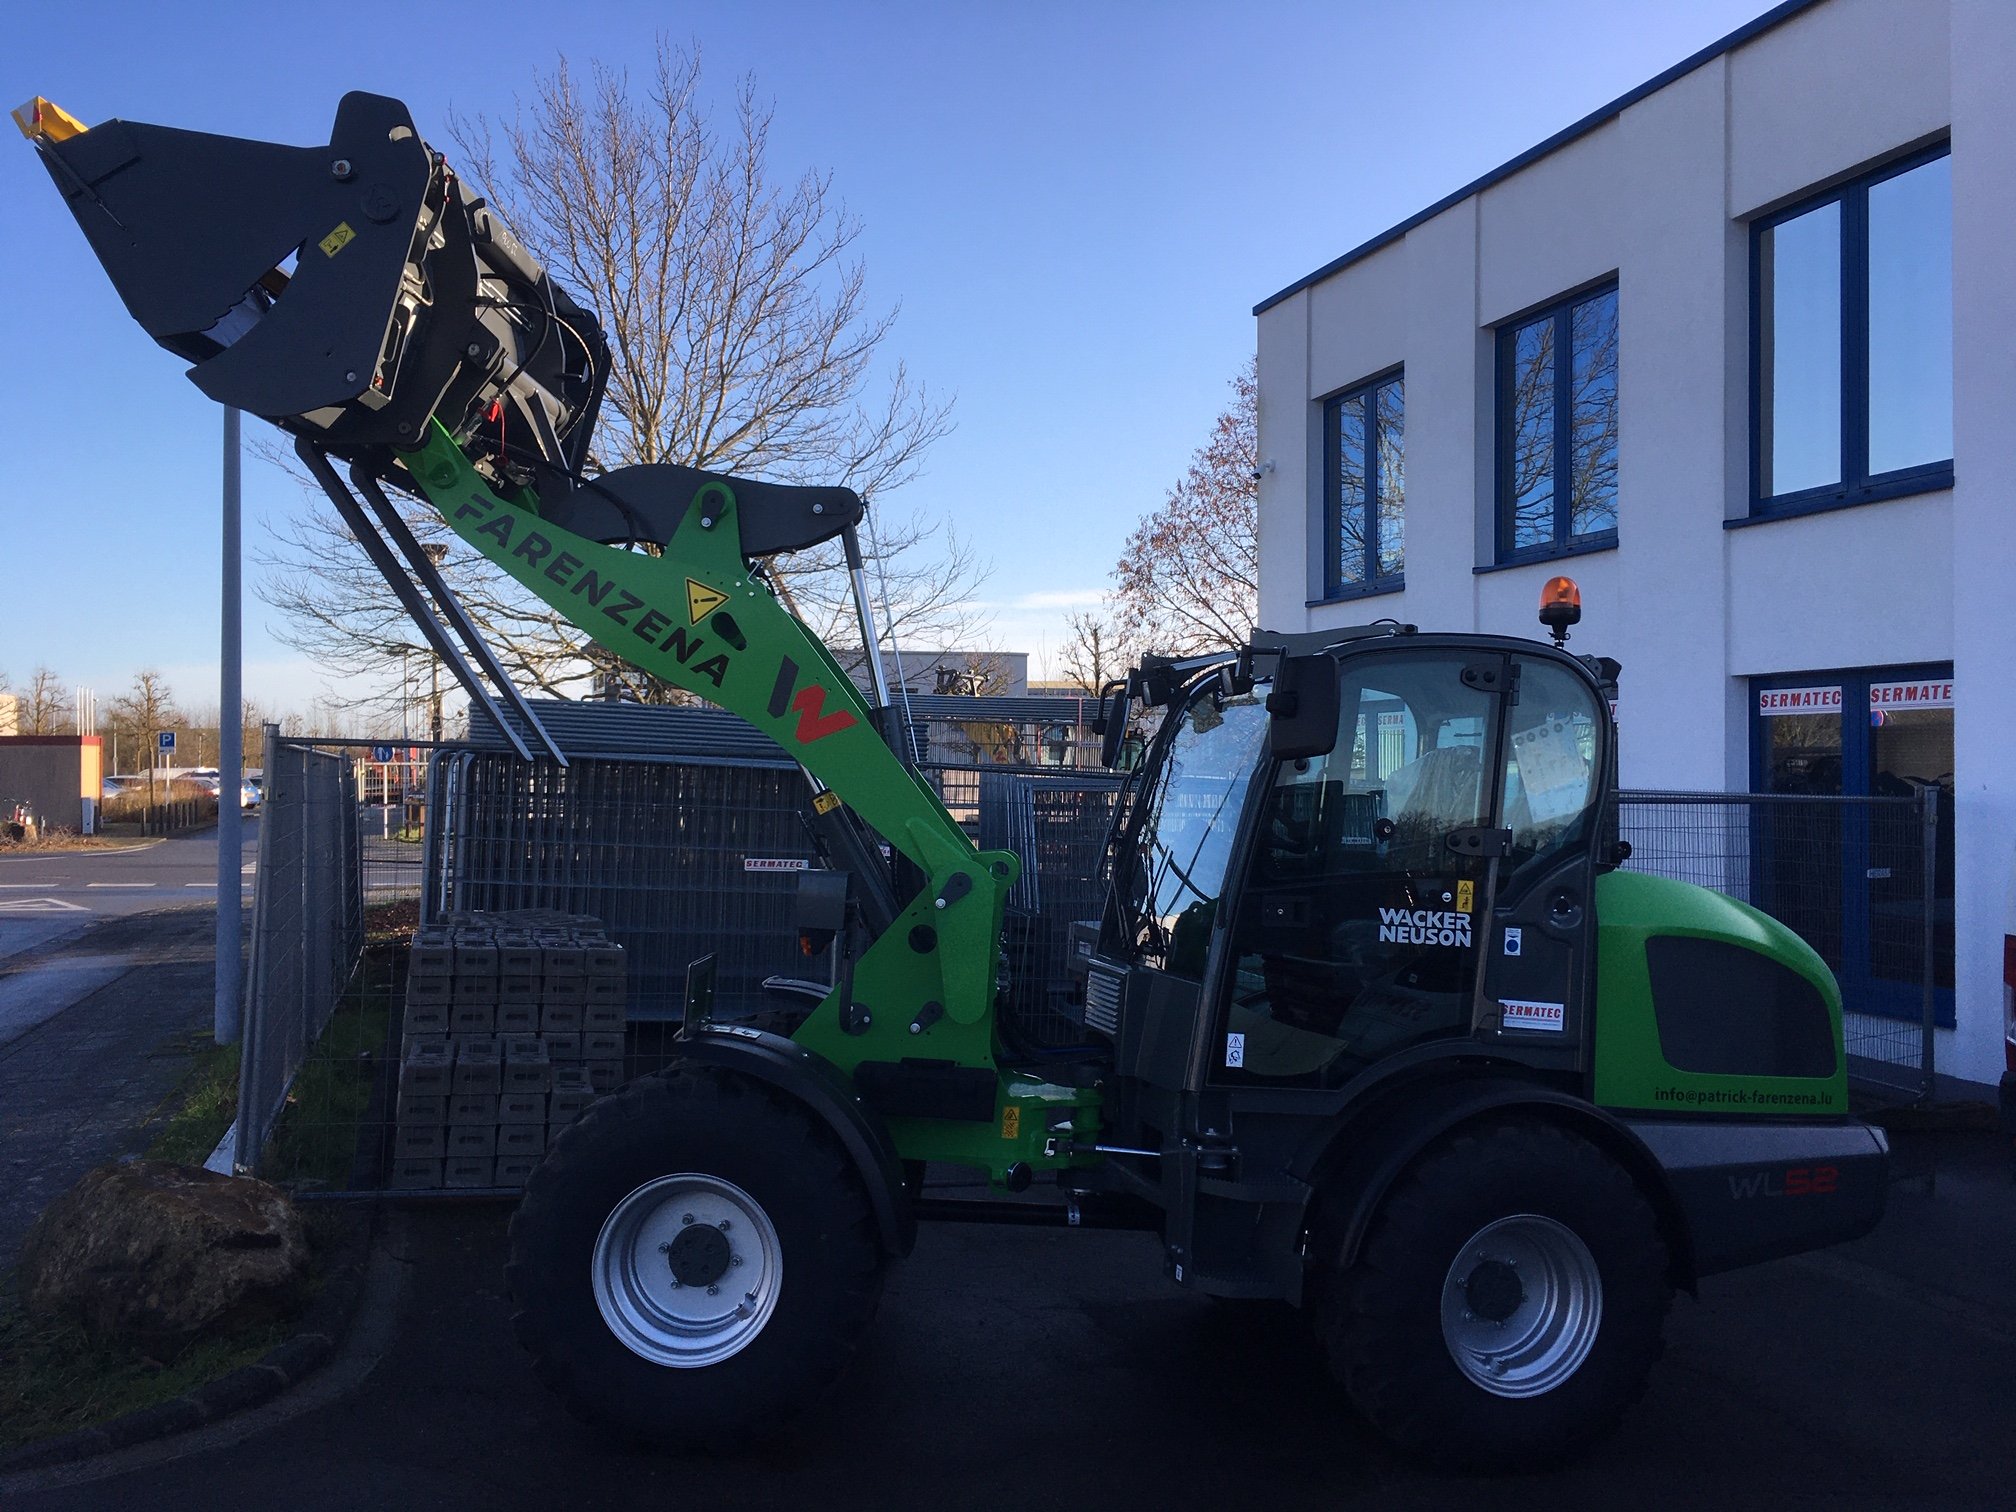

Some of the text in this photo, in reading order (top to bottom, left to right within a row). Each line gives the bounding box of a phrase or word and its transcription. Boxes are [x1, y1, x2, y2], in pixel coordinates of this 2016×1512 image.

[454, 493, 730, 688] FARENZENA
[1760, 690, 1842, 708] SERMATEC
[162, 734, 172, 746] P
[746, 859, 803, 869] SERMATEC
[1378, 907, 1472, 930] WACKER
[1378, 925, 1472, 948] NEUSON
[1503, 1004, 1561, 1019] SERMATEC
[1655, 1087, 1833, 1105] info@patrick-farenzena.lu
[1728, 1167, 1839, 1200] WL52
